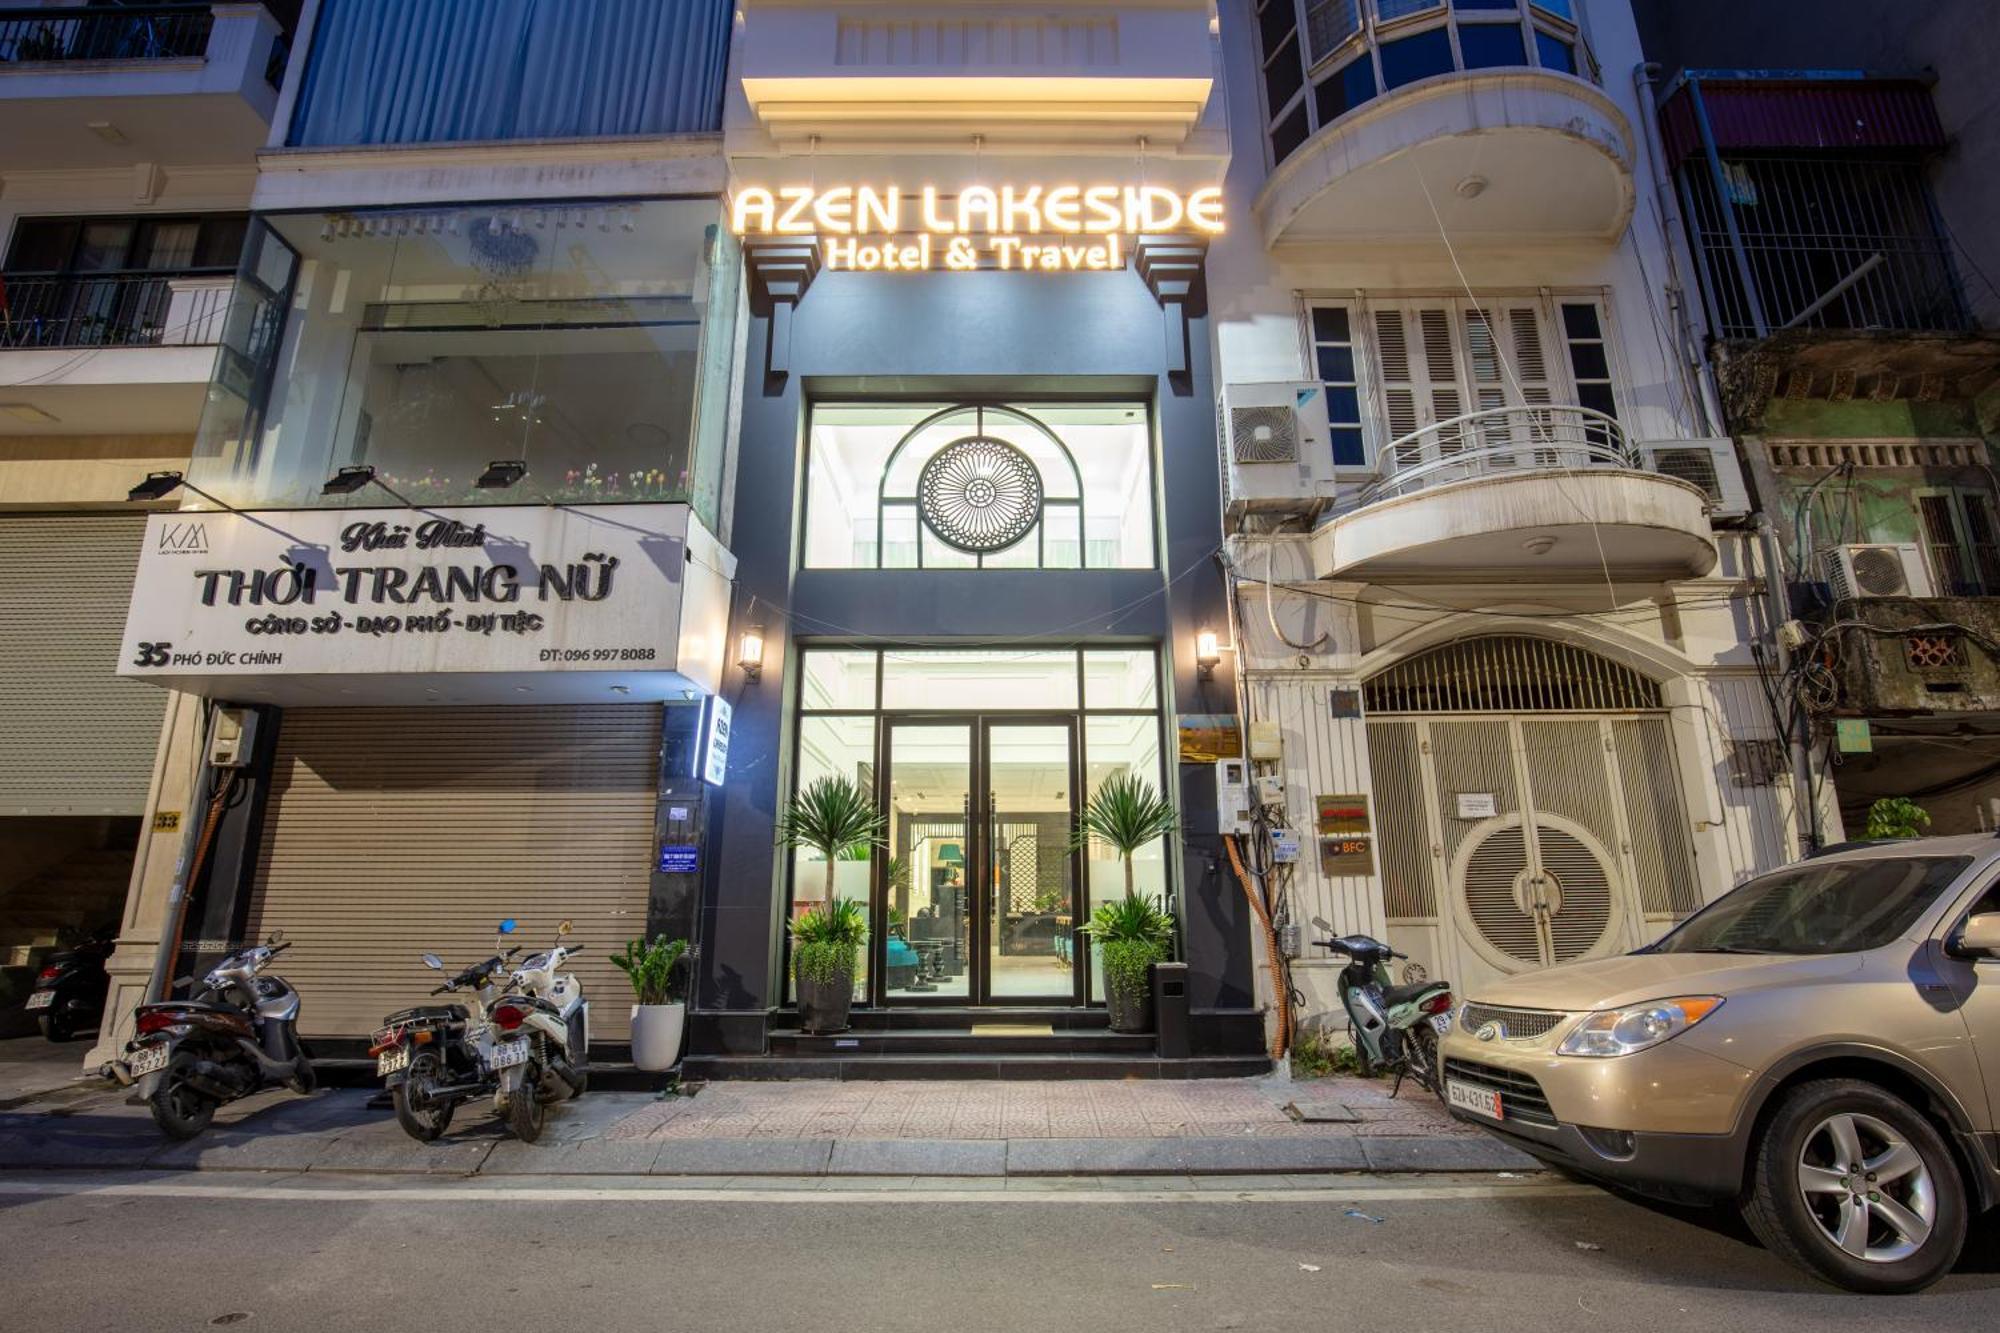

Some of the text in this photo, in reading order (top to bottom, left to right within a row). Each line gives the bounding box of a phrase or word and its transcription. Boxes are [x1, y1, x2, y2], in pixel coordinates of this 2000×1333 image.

[732, 185, 1225, 234] AZEN LAKESIDE
[825, 233, 1121, 270] Hotel & Travel
[415, 520, 485, 549] Minh
[194, 552, 620, 606] THỜI TRANG NỮ
[356, 615, 401, 637] DẠO
[405, 608, 451, 632] PHỐ
[133, 642, 282, 667] 35 PHÓ ĐỨC CHÍNH
[564, 649, 590, 662] 096
[593, 649, 619, 661] 997
[621, 648, 656, 661] 8088
[1343, 841, 1366, 854] BFC
